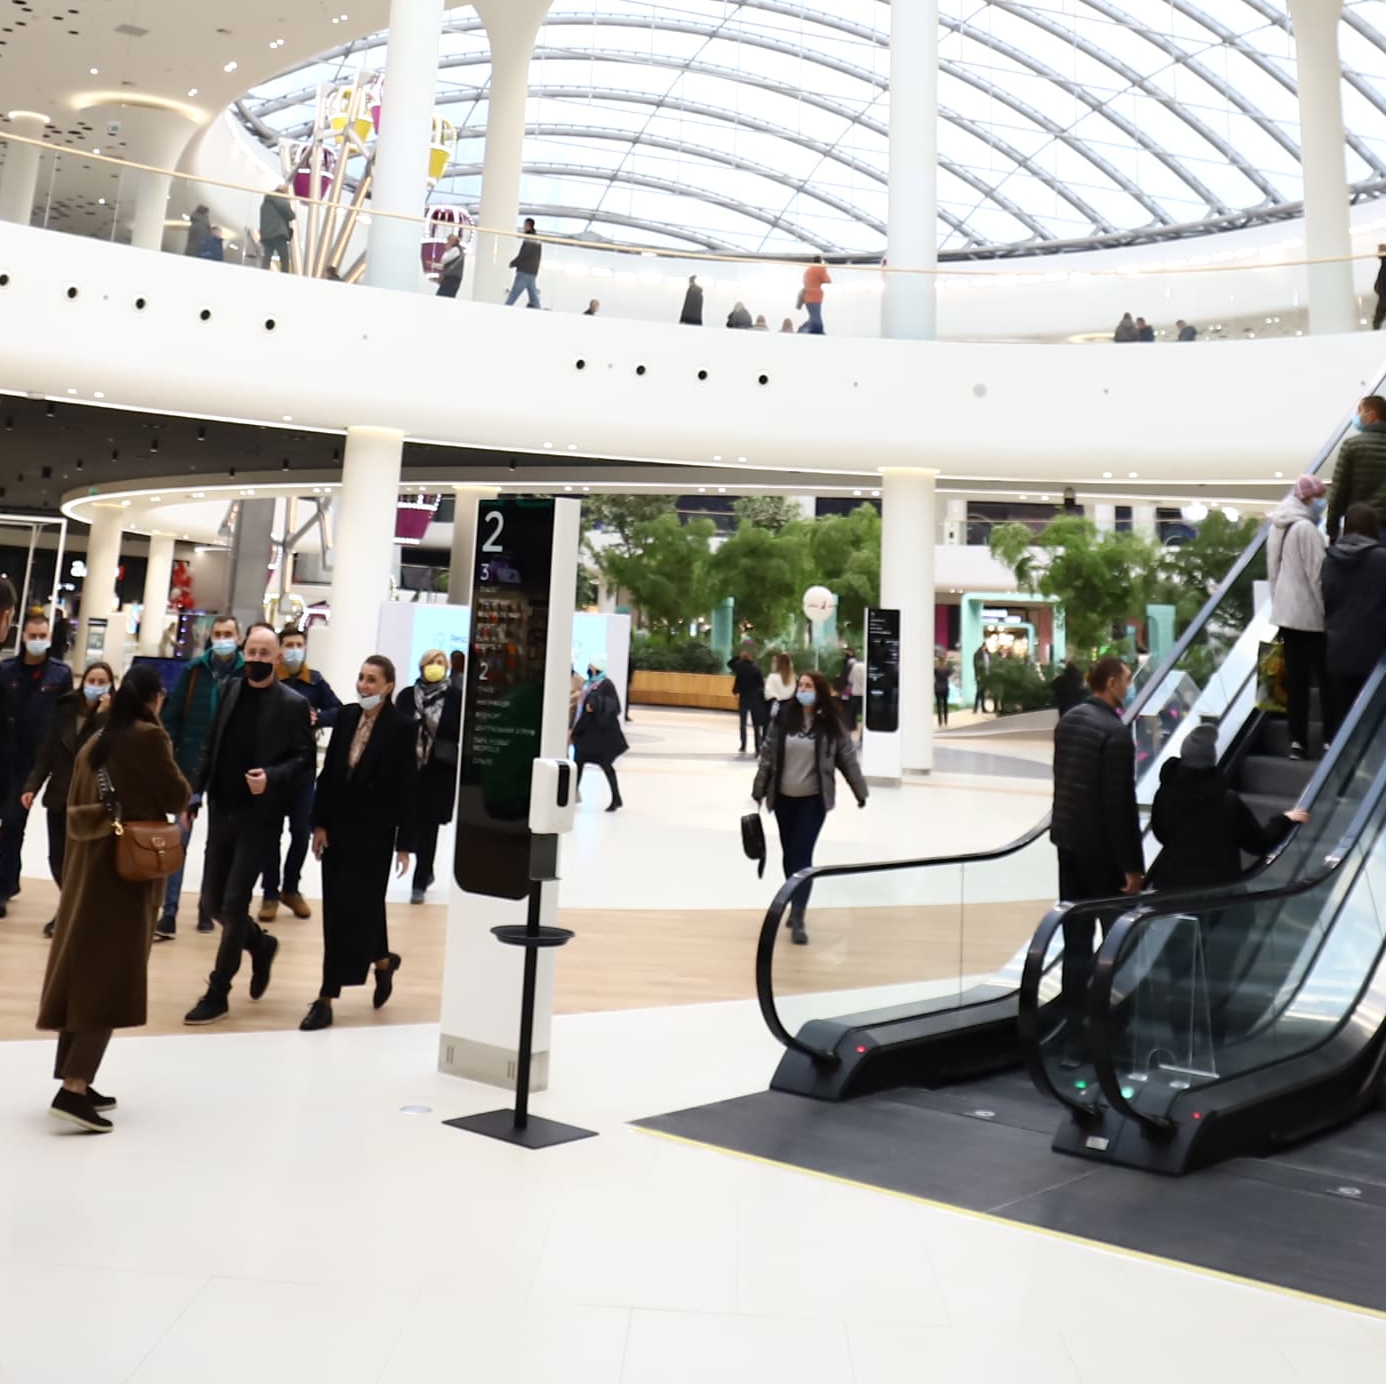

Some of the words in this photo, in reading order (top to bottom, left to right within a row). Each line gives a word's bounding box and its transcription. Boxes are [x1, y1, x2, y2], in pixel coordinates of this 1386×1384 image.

[482, 511, 505, 552] 2
[480, 563, 490, 581] 3
[479, 661, 489, 680] 2
